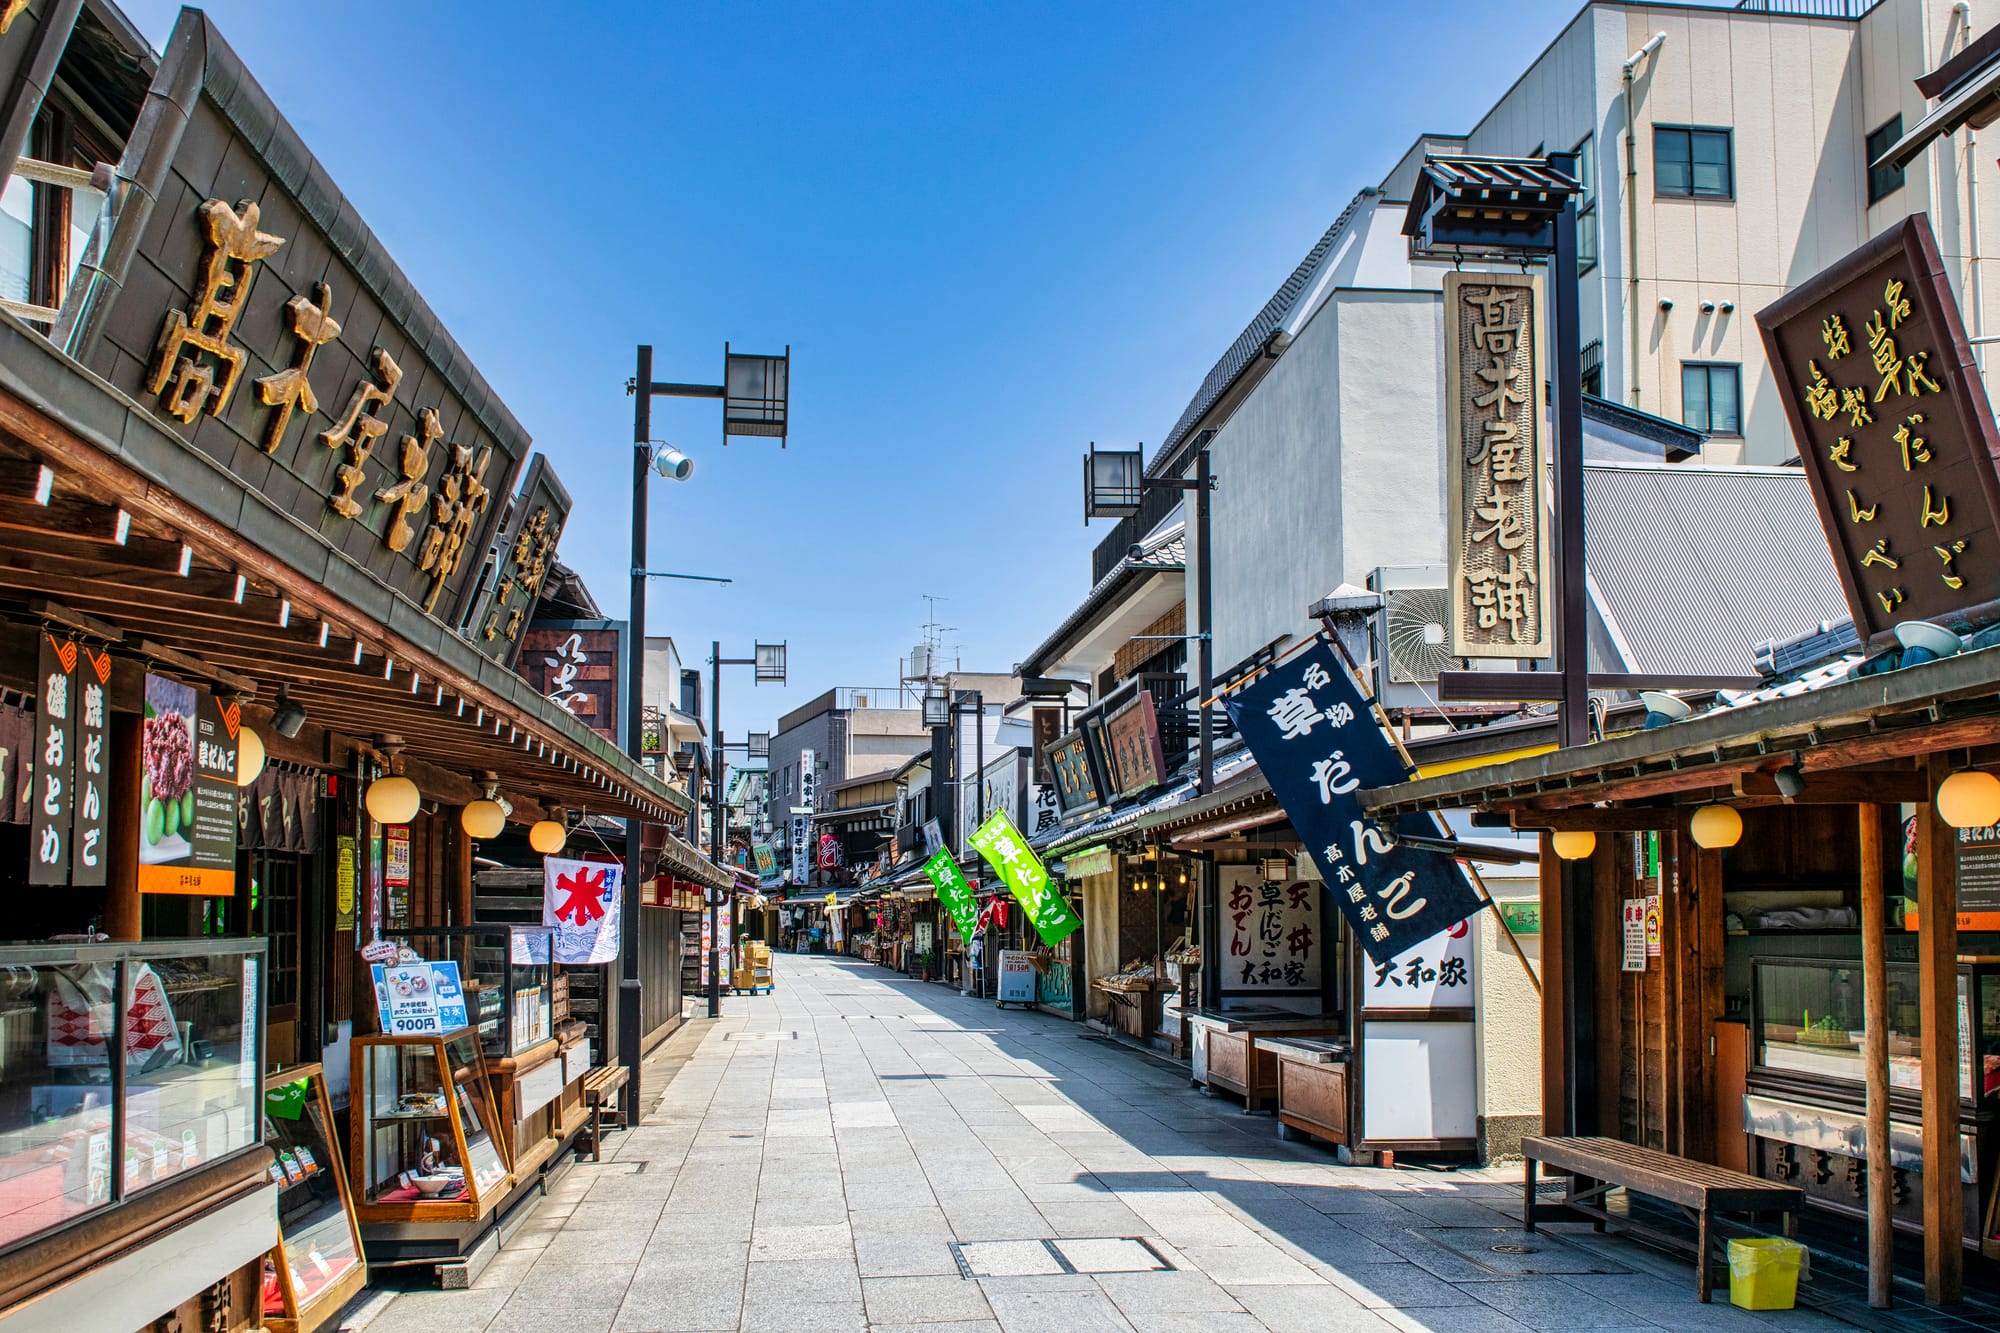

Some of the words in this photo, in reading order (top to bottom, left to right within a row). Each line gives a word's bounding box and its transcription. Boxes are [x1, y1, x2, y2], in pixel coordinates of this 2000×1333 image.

[1884, 279, 1941, 397] 名代
[1463, 287, 1537, 642] 髙木屋老舗
[1865, 309, 1970, 591] 草だんご
[1301, 661, 1355, 730] 名物
[198, 740, 236, 773] 草だんご
[1266, 687, 1429, 920] 草だんご
[554, 866, 607, 927] 氷
[993, 836, 1067, 925] 草だんご
[1229, 880, 1253, 957] おでん
[1257, 880, 1285, 958] 草だんご
[1323, 843, 1391, 943] 髙木屋老舗
[1286, 882, 1313, 961] 天丼
[1240, 960, 1308, 986] 大和家
[1374, 956, 1468, 989] 大和家
[396, 1018, 436, 1031] 900円
